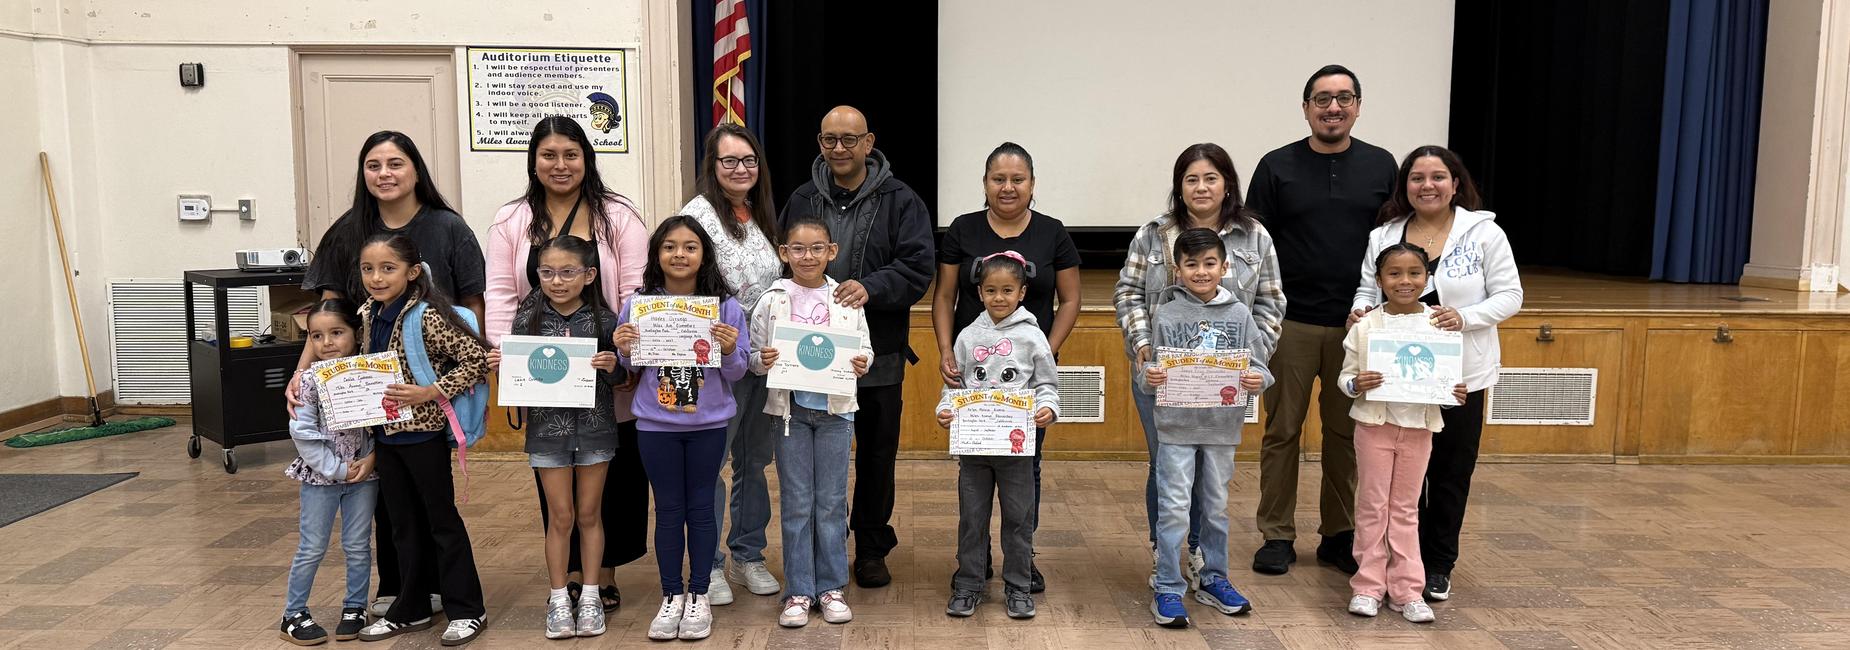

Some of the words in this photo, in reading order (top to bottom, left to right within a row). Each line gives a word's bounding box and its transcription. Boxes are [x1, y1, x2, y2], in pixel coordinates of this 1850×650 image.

[482, 53, 550, 61] Auditorium
[555, 54, 611, 64] Etiquette
[1446, 262, 1479, 279] CLUB
[638, 301, 670, 314] STUDENT
[684, 302, 711, 316] MONTH
[799, 345, 833, 359] KINDNESS
[322, 362, 352, 378] STUDENT
[365, 361, 393, 370] MONTH
[530, 359, 568, 370] KINDNESS
[1166, 357, 1199, 367] STUDENT
[1213, 358, 1241, 368] MONTH
[957, 393, 987, 405] STUDENT
[1001, 394, 1027, 407] MONTH
